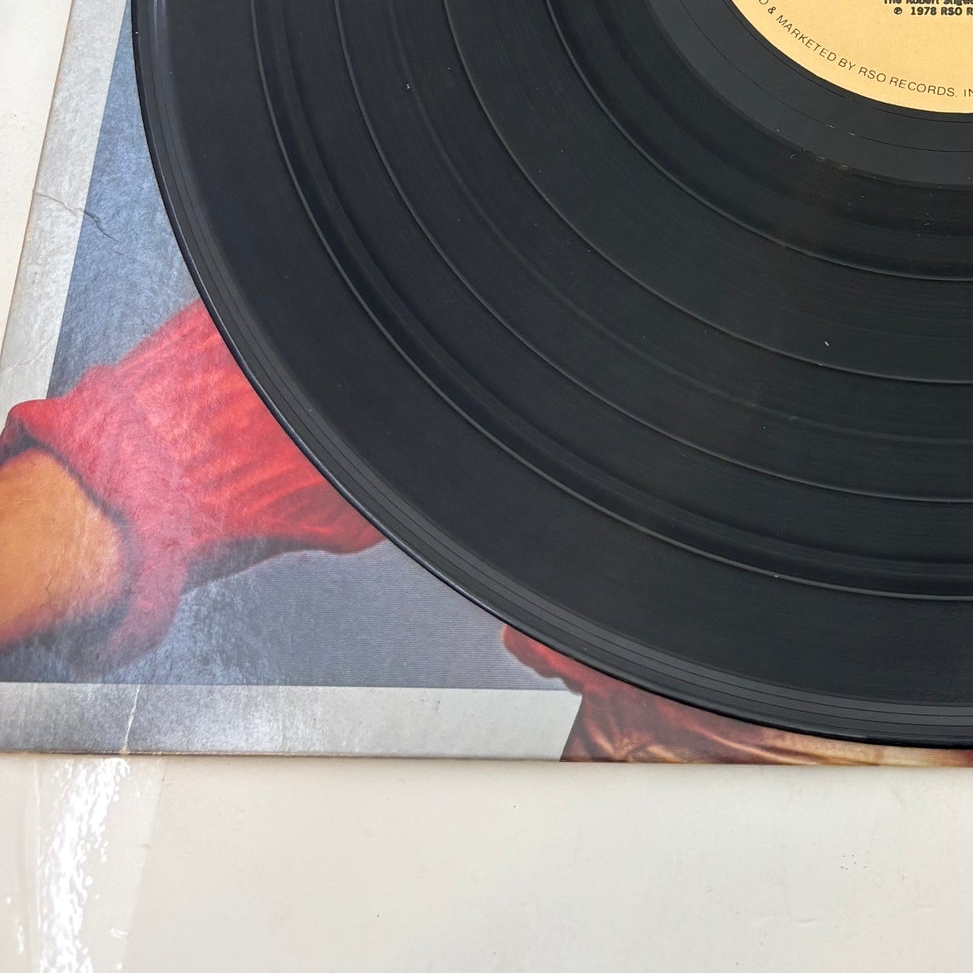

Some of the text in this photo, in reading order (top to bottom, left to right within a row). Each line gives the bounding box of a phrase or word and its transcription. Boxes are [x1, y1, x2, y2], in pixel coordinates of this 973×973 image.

[910, 7, 937, 15] 1978
[941, 7, 962, 16] RSO
[767, 5, 777, 15] &
[776, 14, 837, 62] MARKETED
[838, 57, 857, 71] BY
[858, 66, 887, 83] RSO
